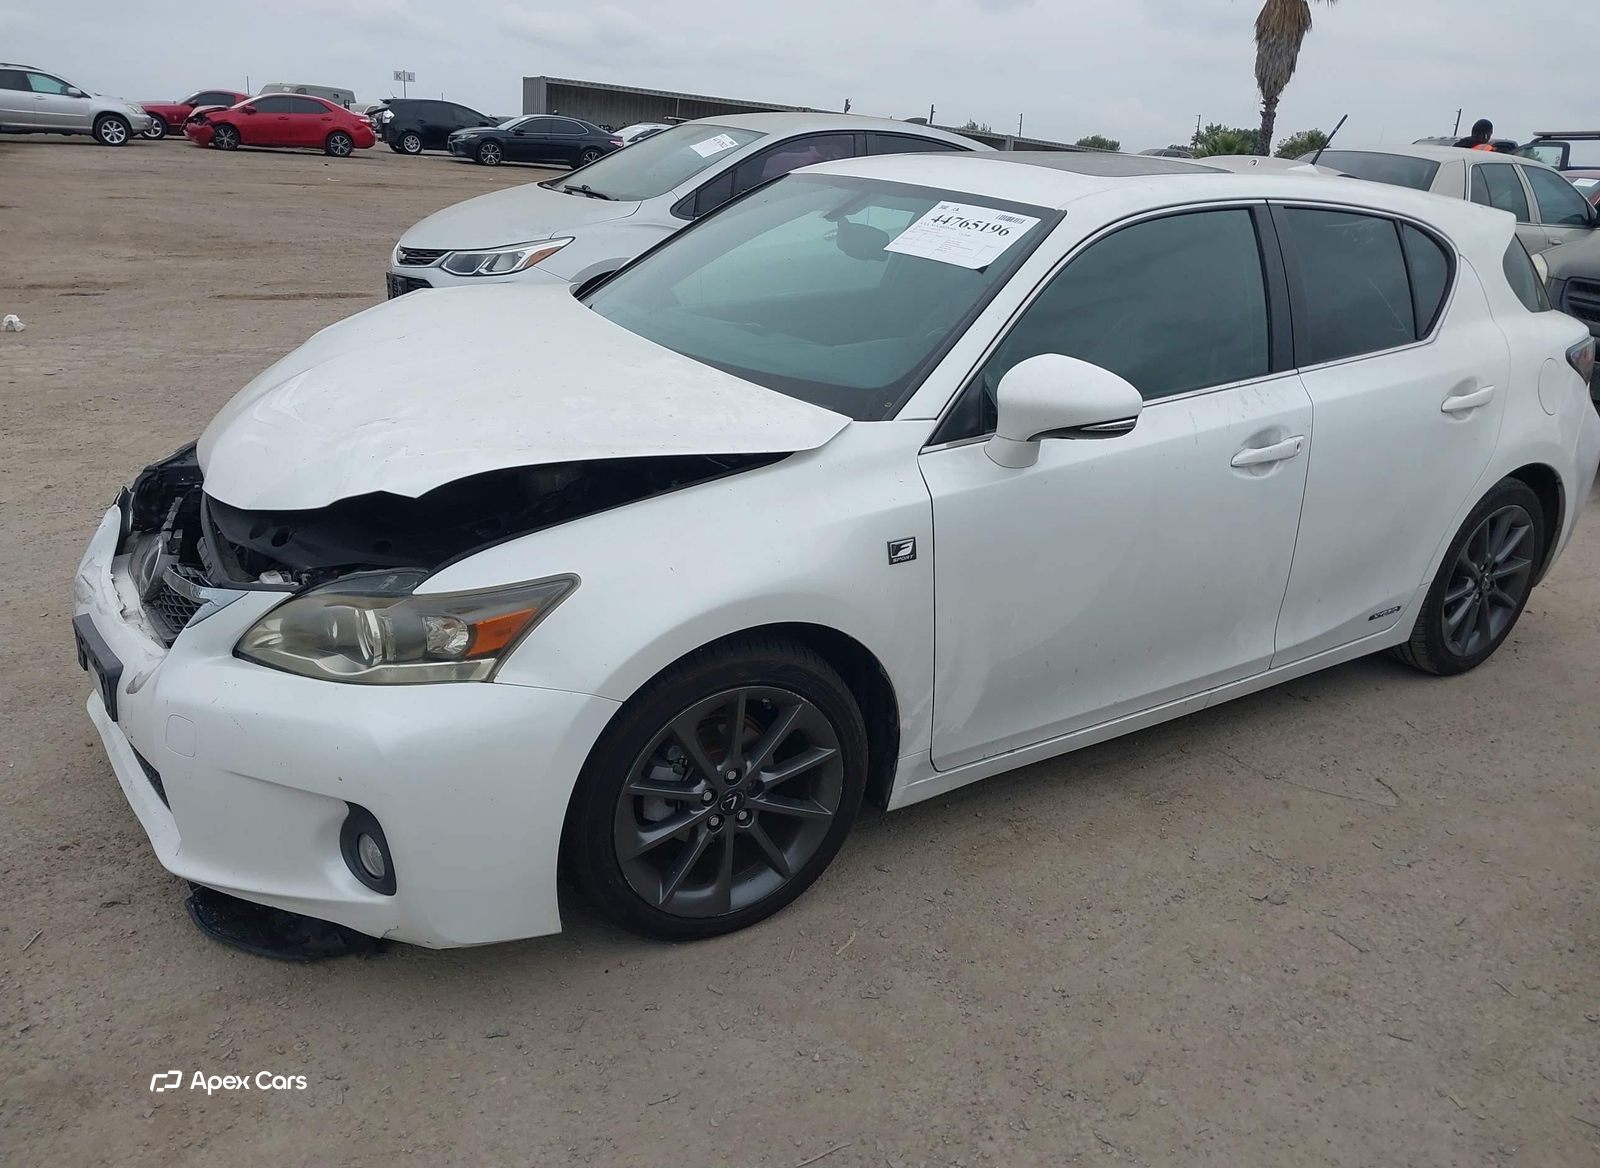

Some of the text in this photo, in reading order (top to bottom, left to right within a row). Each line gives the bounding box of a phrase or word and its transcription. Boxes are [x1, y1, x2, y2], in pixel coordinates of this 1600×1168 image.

[395, 72, 401, 80] K
[408, 73, 413, 81] L
[930, 214, 1014, 236] 44765196
